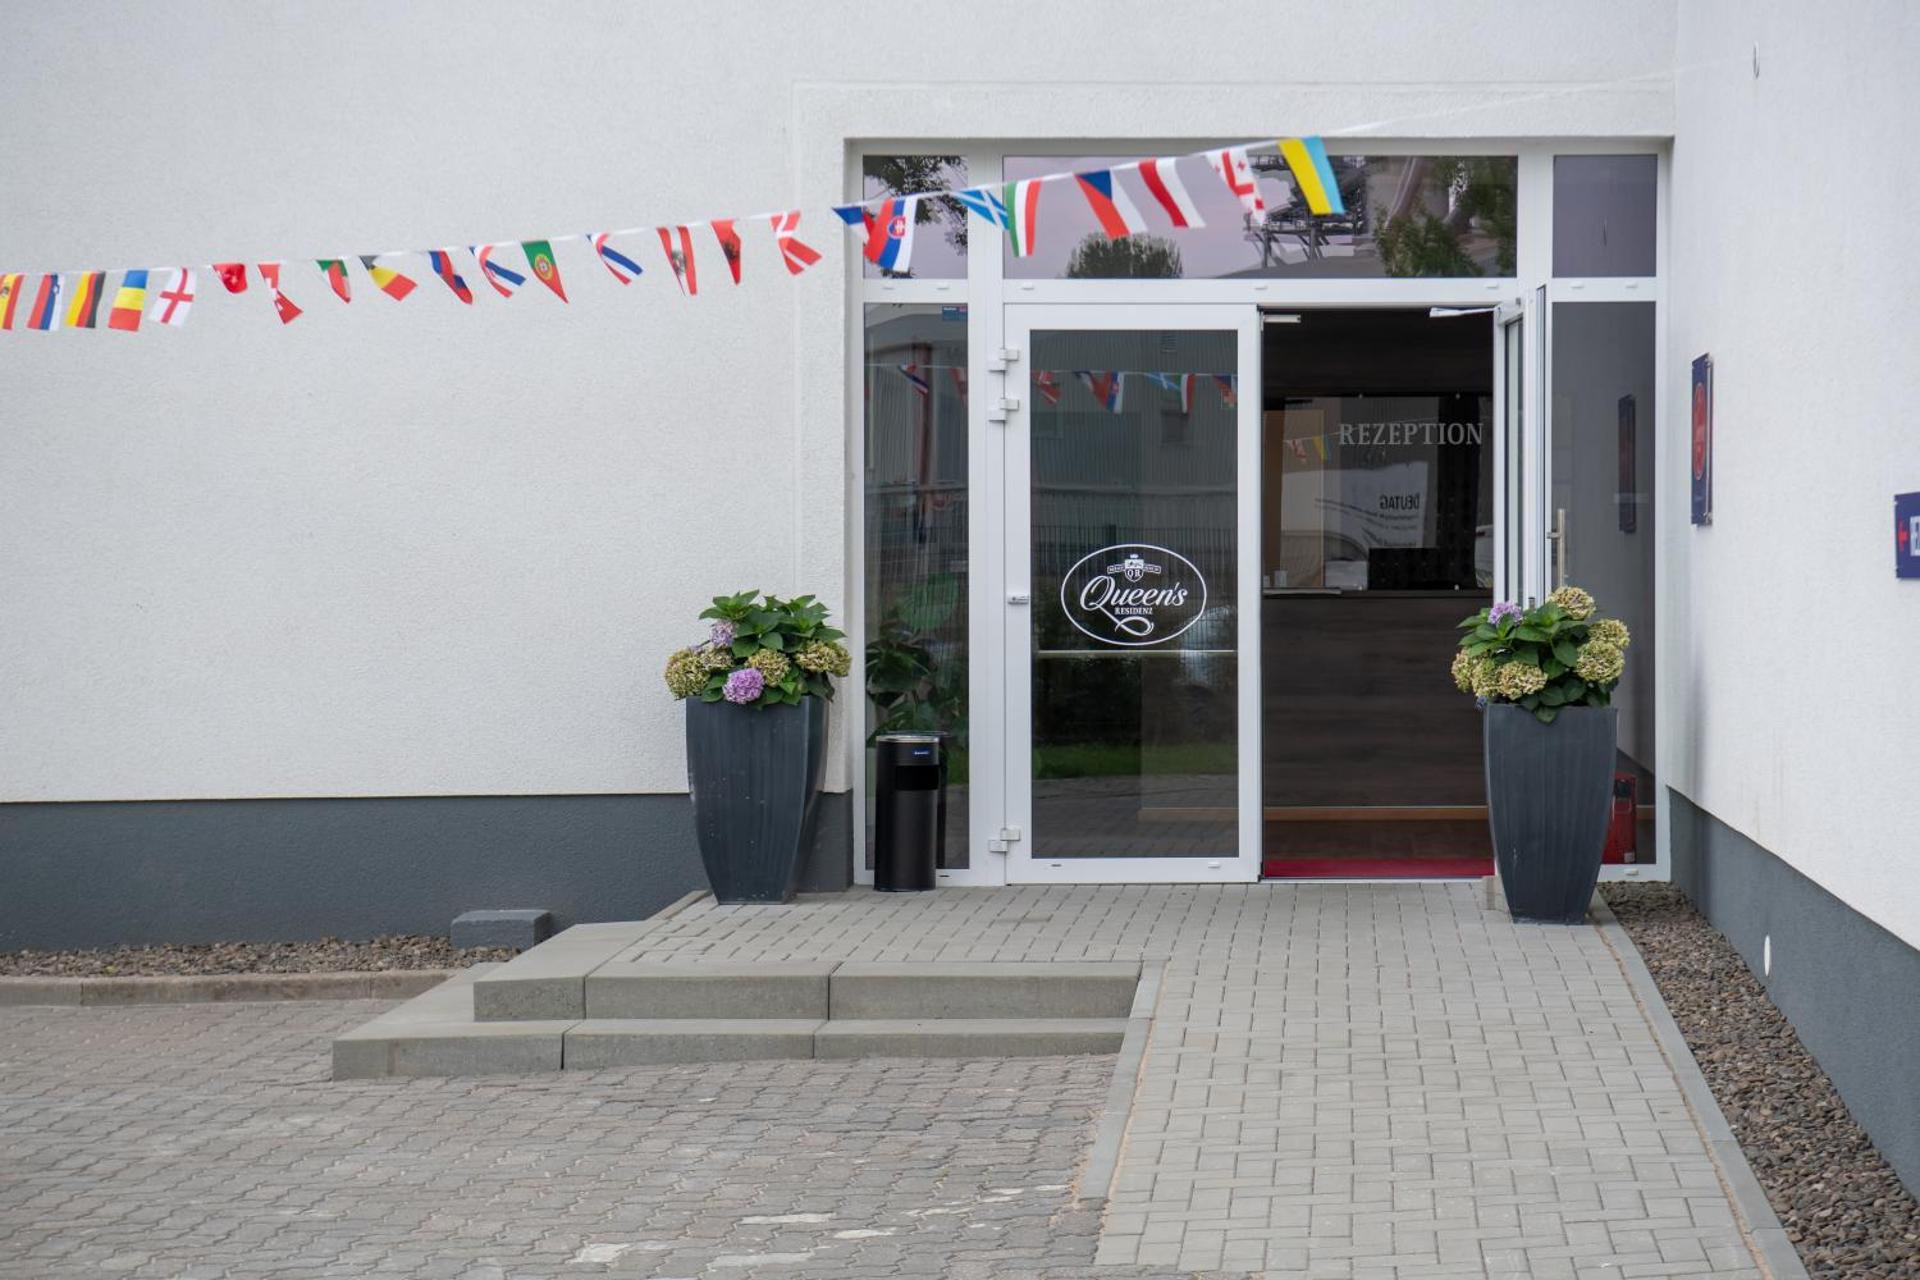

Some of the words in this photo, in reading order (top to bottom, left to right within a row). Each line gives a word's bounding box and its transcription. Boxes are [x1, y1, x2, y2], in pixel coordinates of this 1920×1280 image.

[1339, 423, 1483, 446] REZEPTION
[1081, 575, 1188, 636] Queen's
[1115, 607, 1153, 615] RESIDENZ
